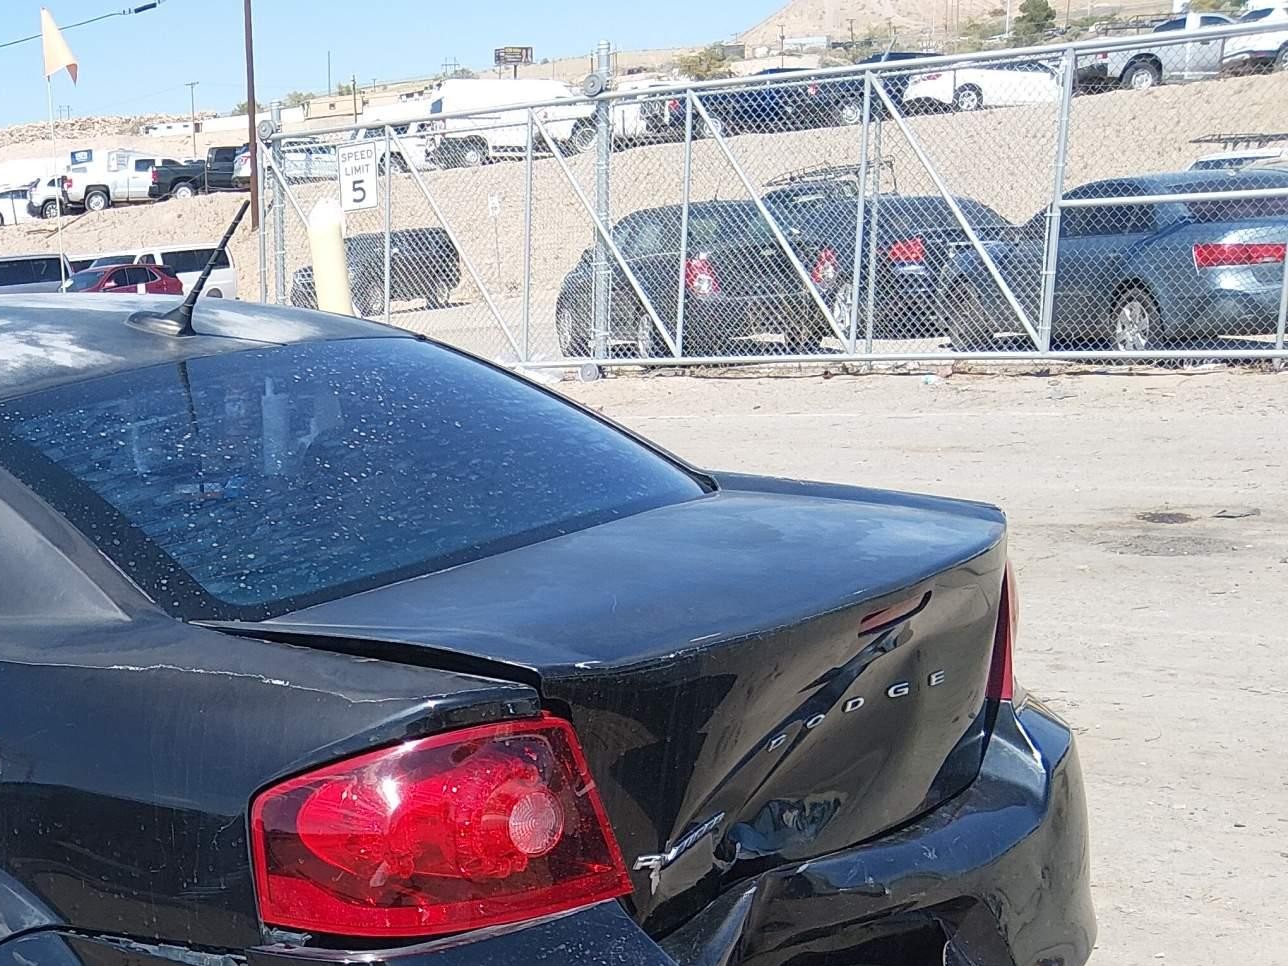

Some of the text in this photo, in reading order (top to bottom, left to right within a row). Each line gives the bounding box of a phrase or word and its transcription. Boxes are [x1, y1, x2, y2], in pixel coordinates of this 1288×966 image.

[341, 149, 372, 162] SPEED
[344, 164, 370, 176] LIMIT
[352, 179, 366, 203] 5
[767, 670, 945, 753] DODGE
